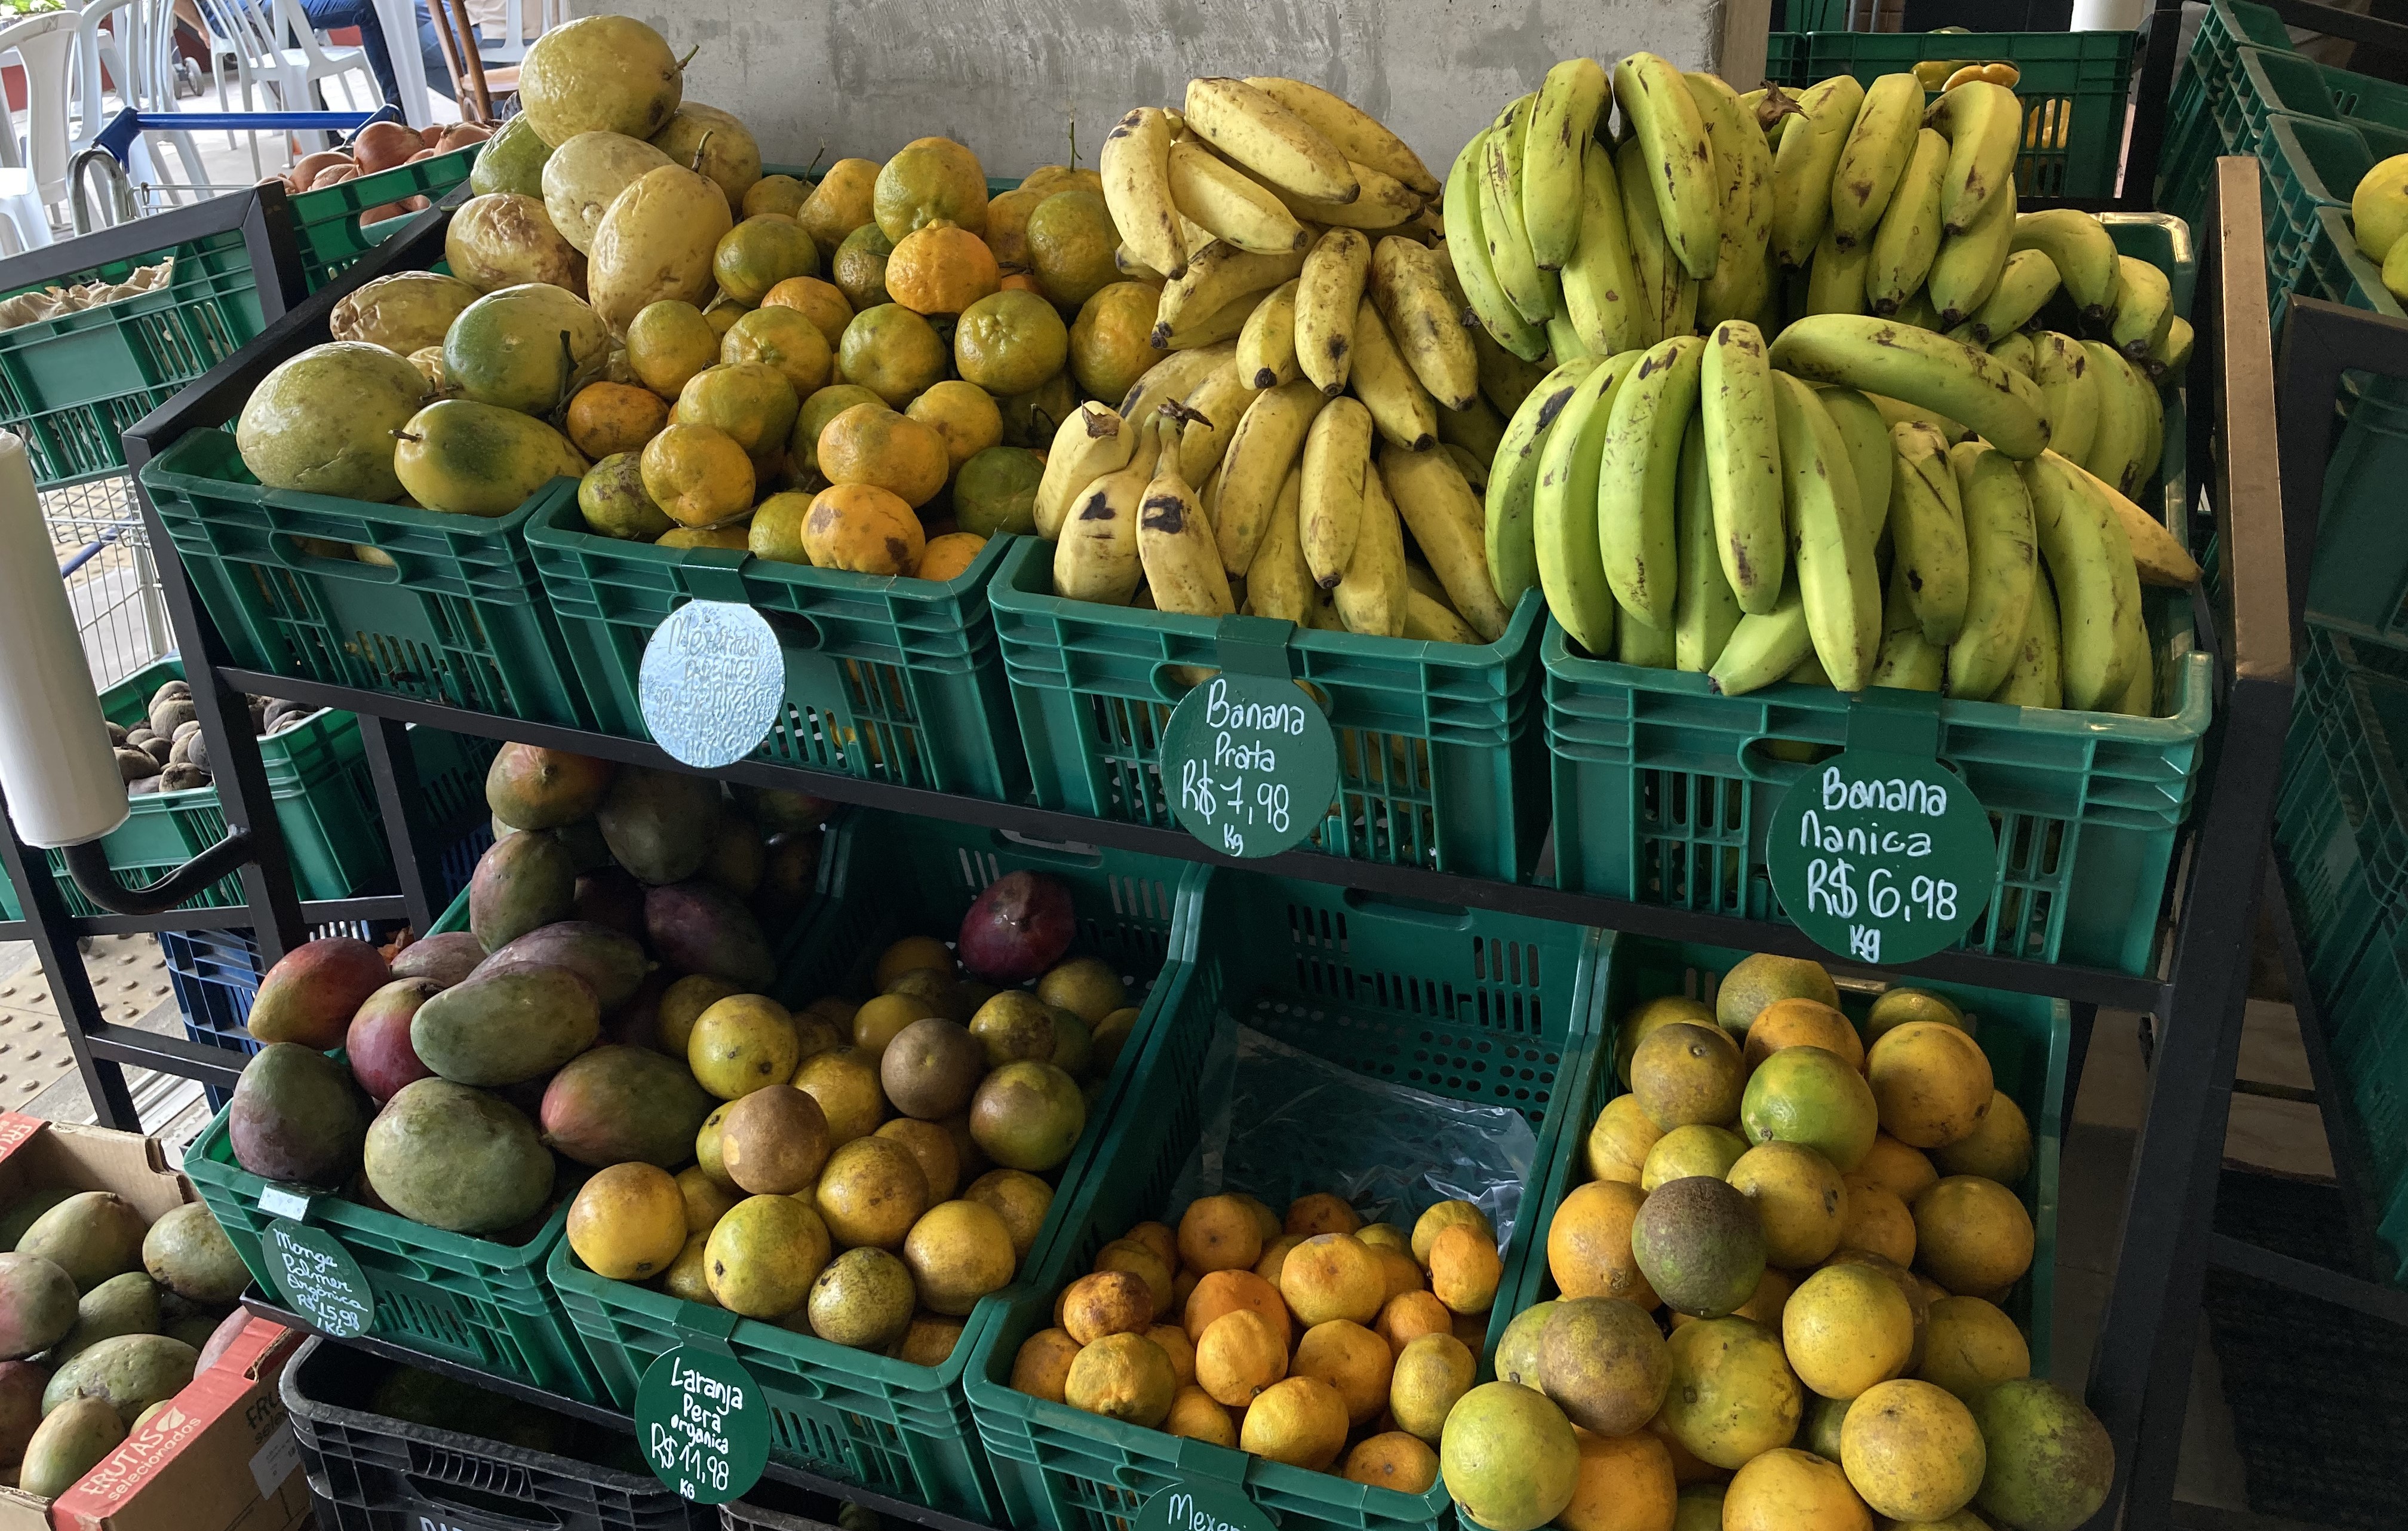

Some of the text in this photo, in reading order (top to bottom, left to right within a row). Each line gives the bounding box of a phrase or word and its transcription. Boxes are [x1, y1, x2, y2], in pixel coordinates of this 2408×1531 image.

[1206, 679, 1304, 735] Banana
[1215, 731, 1275, 772] Prata
[1822, 766, 1947, 816] Banana
[1800, 809, 1931, 857] Nanica
[671, 1357, 743, 1416] Laranja
[683, 1393, 721, 1434] Pera
[79, 1428, 164, 1495] FRUTAS
[108, 1418, 202, 1501] selecionadas
